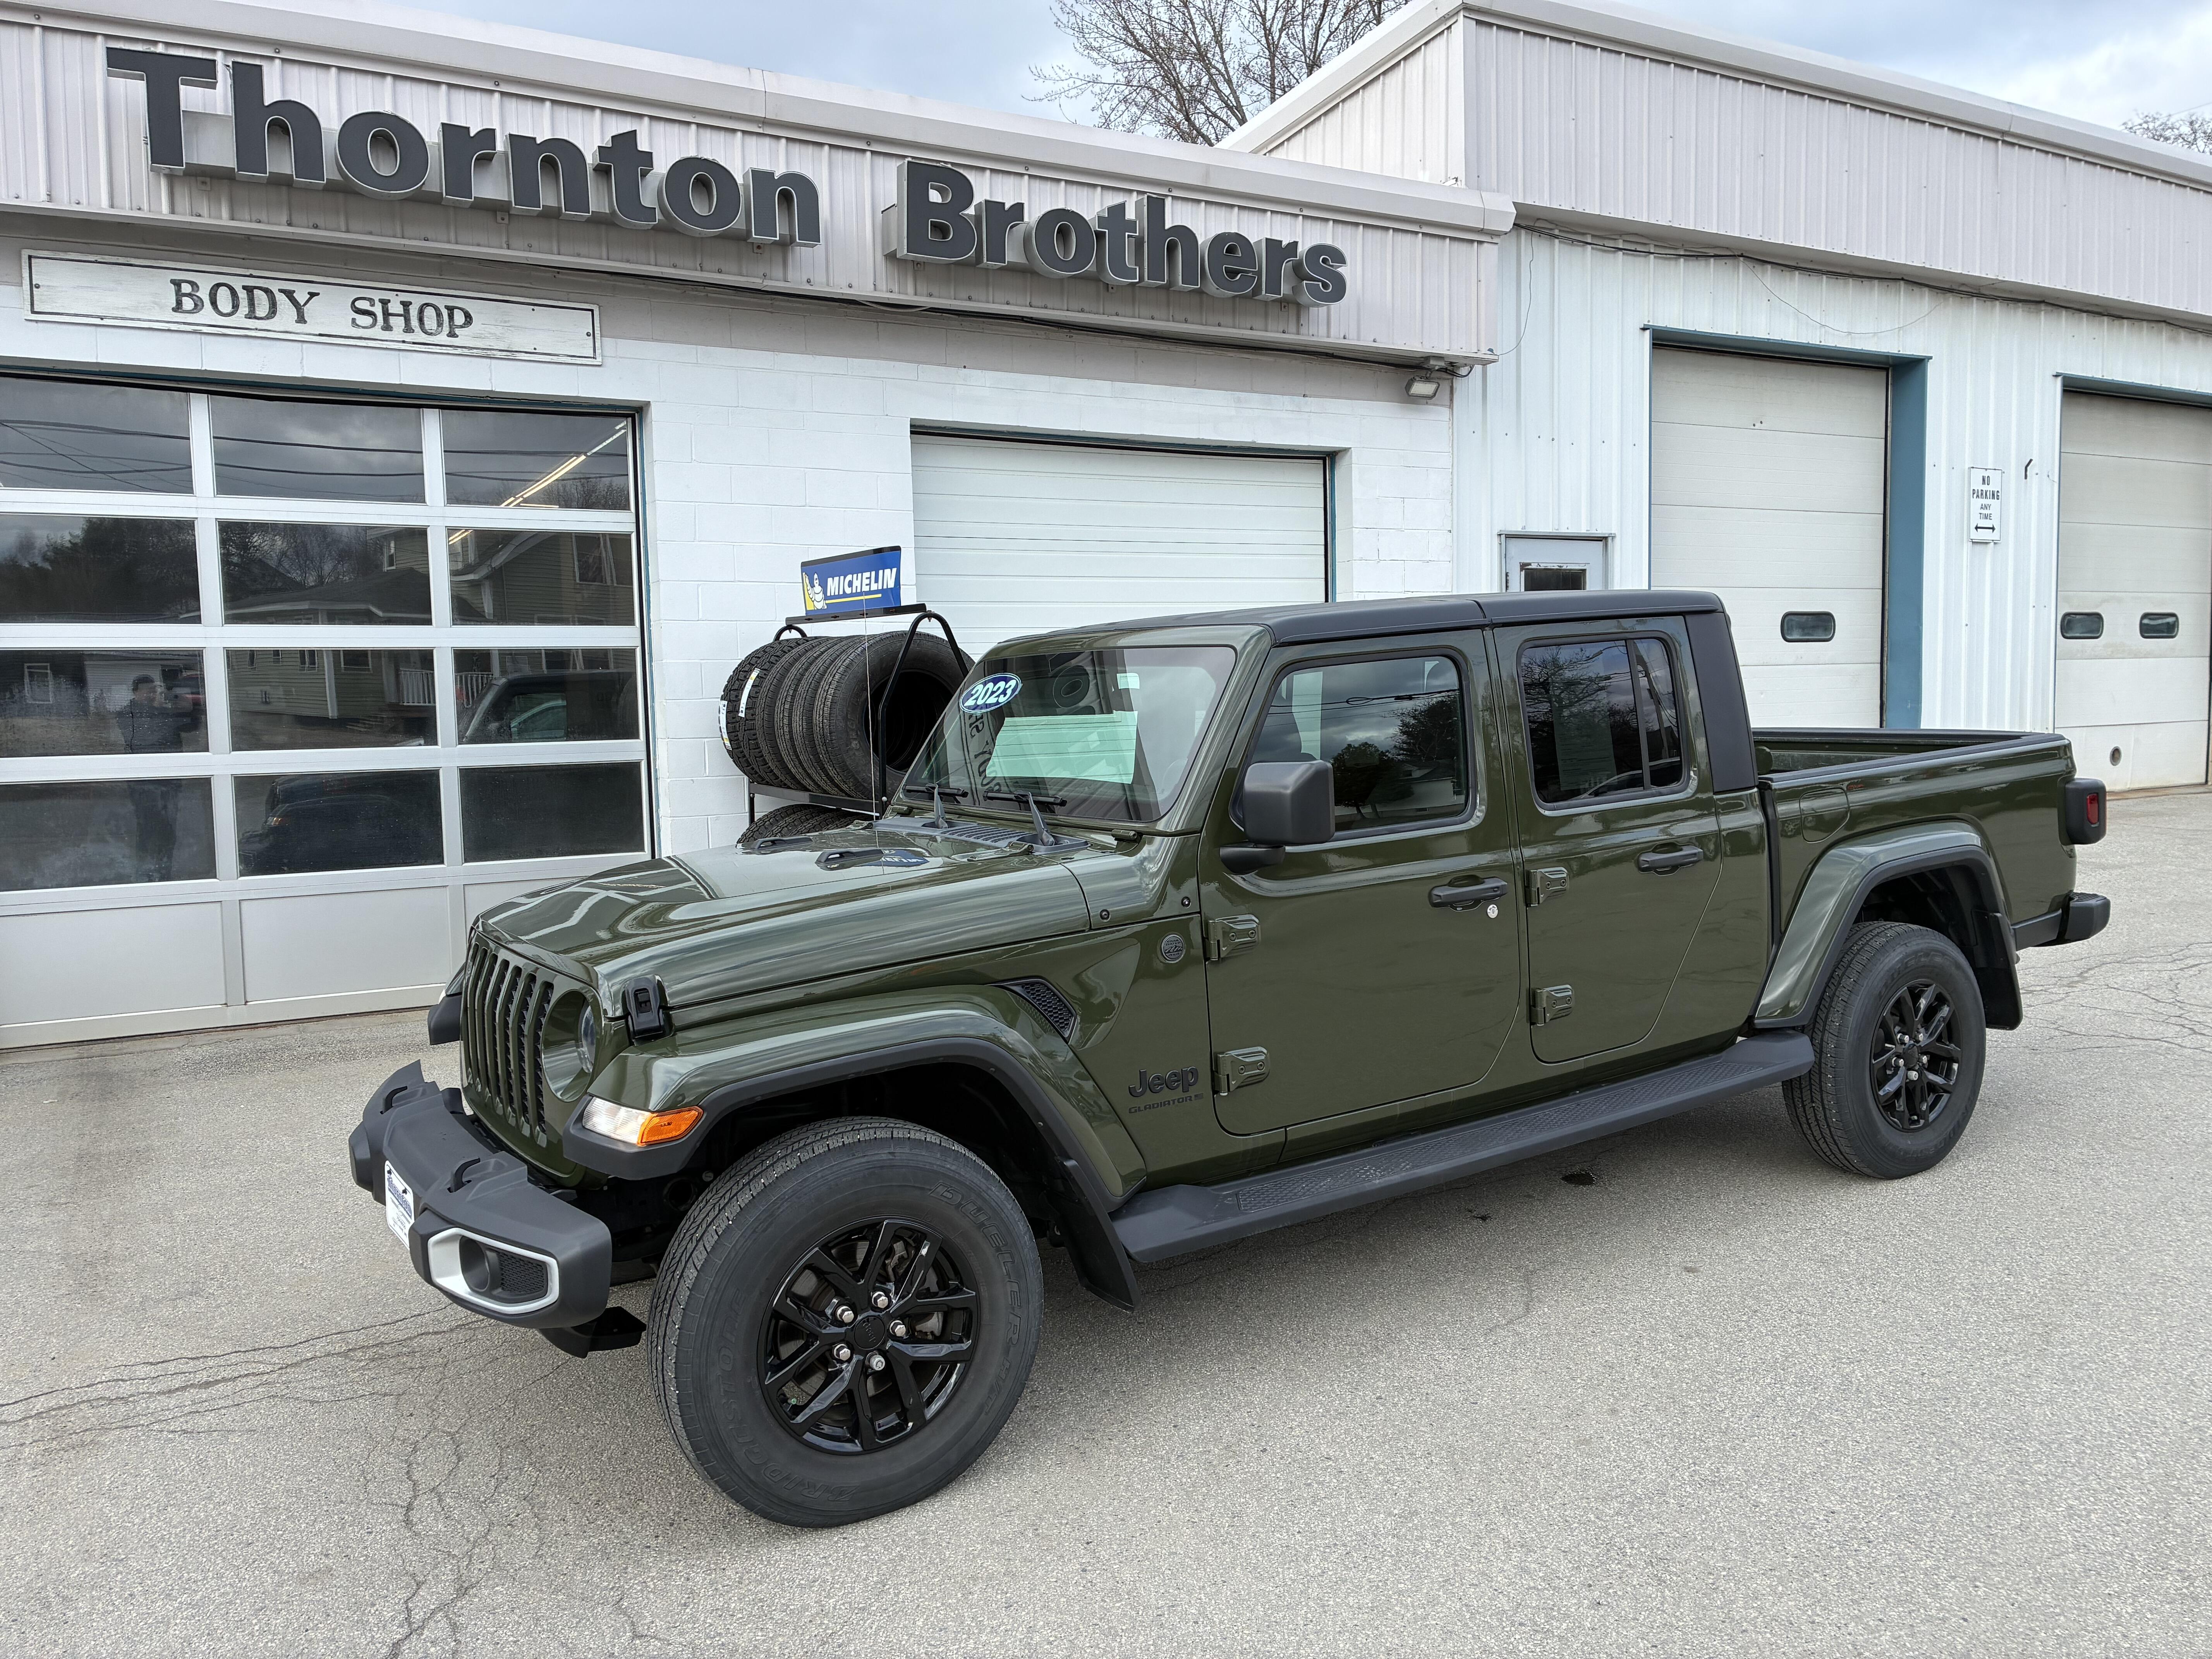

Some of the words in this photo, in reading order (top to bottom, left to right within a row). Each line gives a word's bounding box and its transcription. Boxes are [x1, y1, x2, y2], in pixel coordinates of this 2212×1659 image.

[106, 46, 822, 246] Thornton
[900, 160, 1347, 306] Brothers
[170, 278, 320, 325] BODY
[350, 296, 474, 339] SHOP
[1972, 489, 2000, 500] PARKING
[1982, 475, 1990, 486] NO
[826, 567, 898, 597] MICHELIN
[966, 680, 1015, 705] 2023
[1128, 1066, 1199, 1097] Jeep
[1128, 1096, 1193, 1114] GLADIATOR
[928, 1181, 1021, 1349] DUELER
[719, 1286, 861, 1502] BRIDGESTONE
